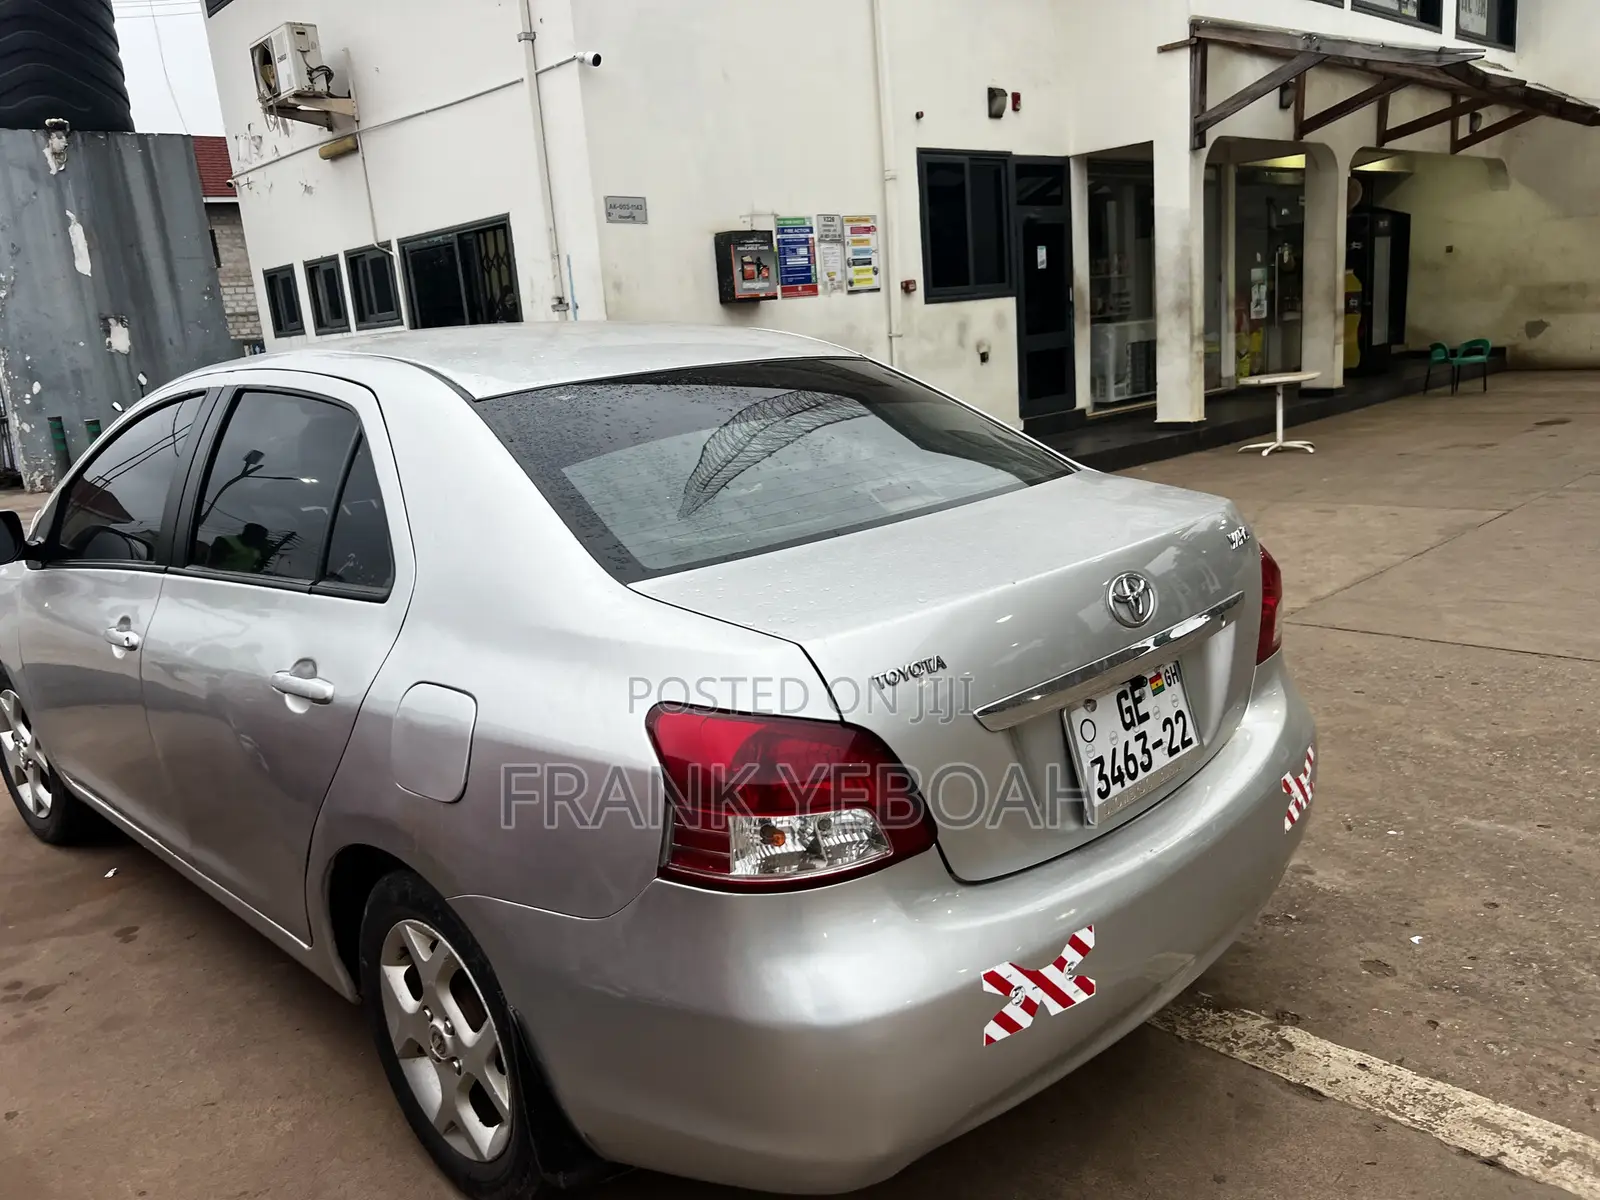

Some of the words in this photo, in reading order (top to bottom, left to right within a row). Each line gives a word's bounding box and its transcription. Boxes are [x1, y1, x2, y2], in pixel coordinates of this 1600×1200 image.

[872, 655, 947, 689] TOYOTA
[1116, 685, 1150, 731] GE
[1164, 664, 1180, 687] GH
[1090, 709, 1193, 800] 3463-22
